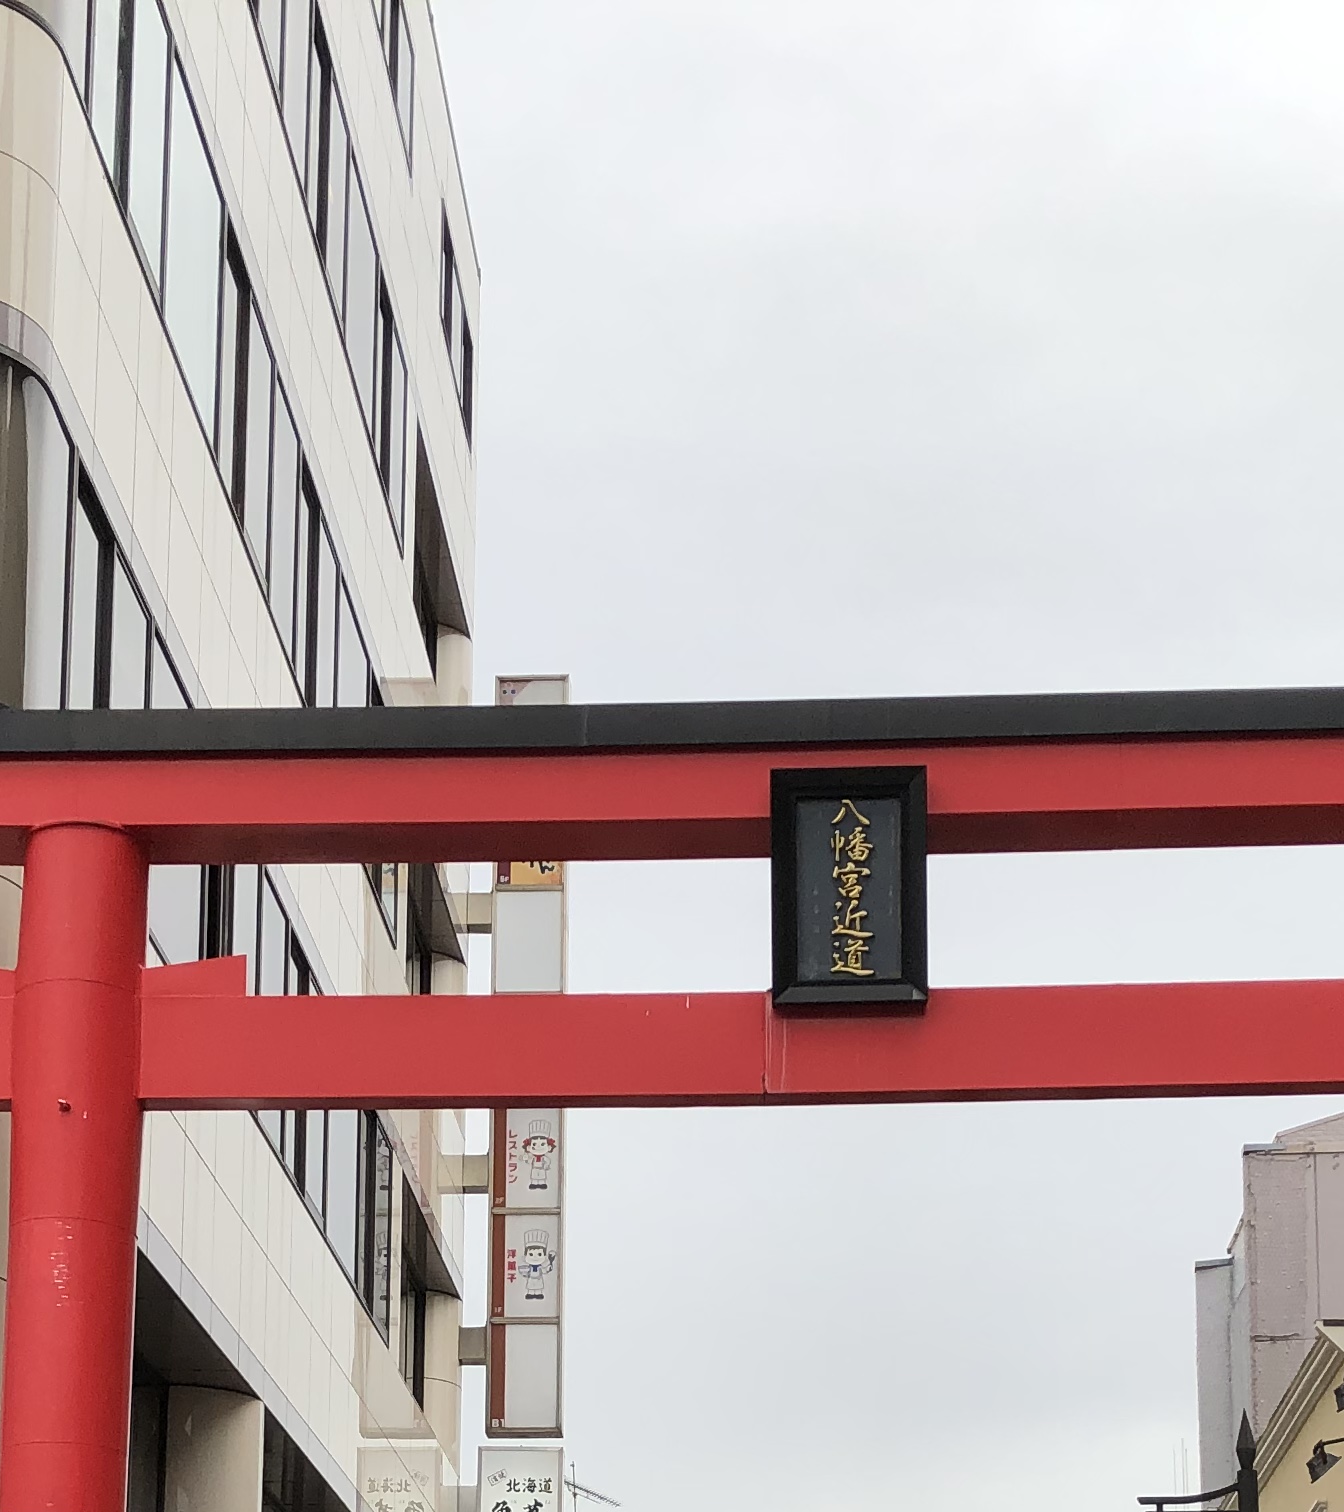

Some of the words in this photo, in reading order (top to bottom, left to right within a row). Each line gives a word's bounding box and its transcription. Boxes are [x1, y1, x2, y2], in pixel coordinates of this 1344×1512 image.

[830, 799, 875, 977] 八幡宮近道
[508, 1129, 519, 1184] レストラン
[506, 1477, 553, 1493] 北海道
